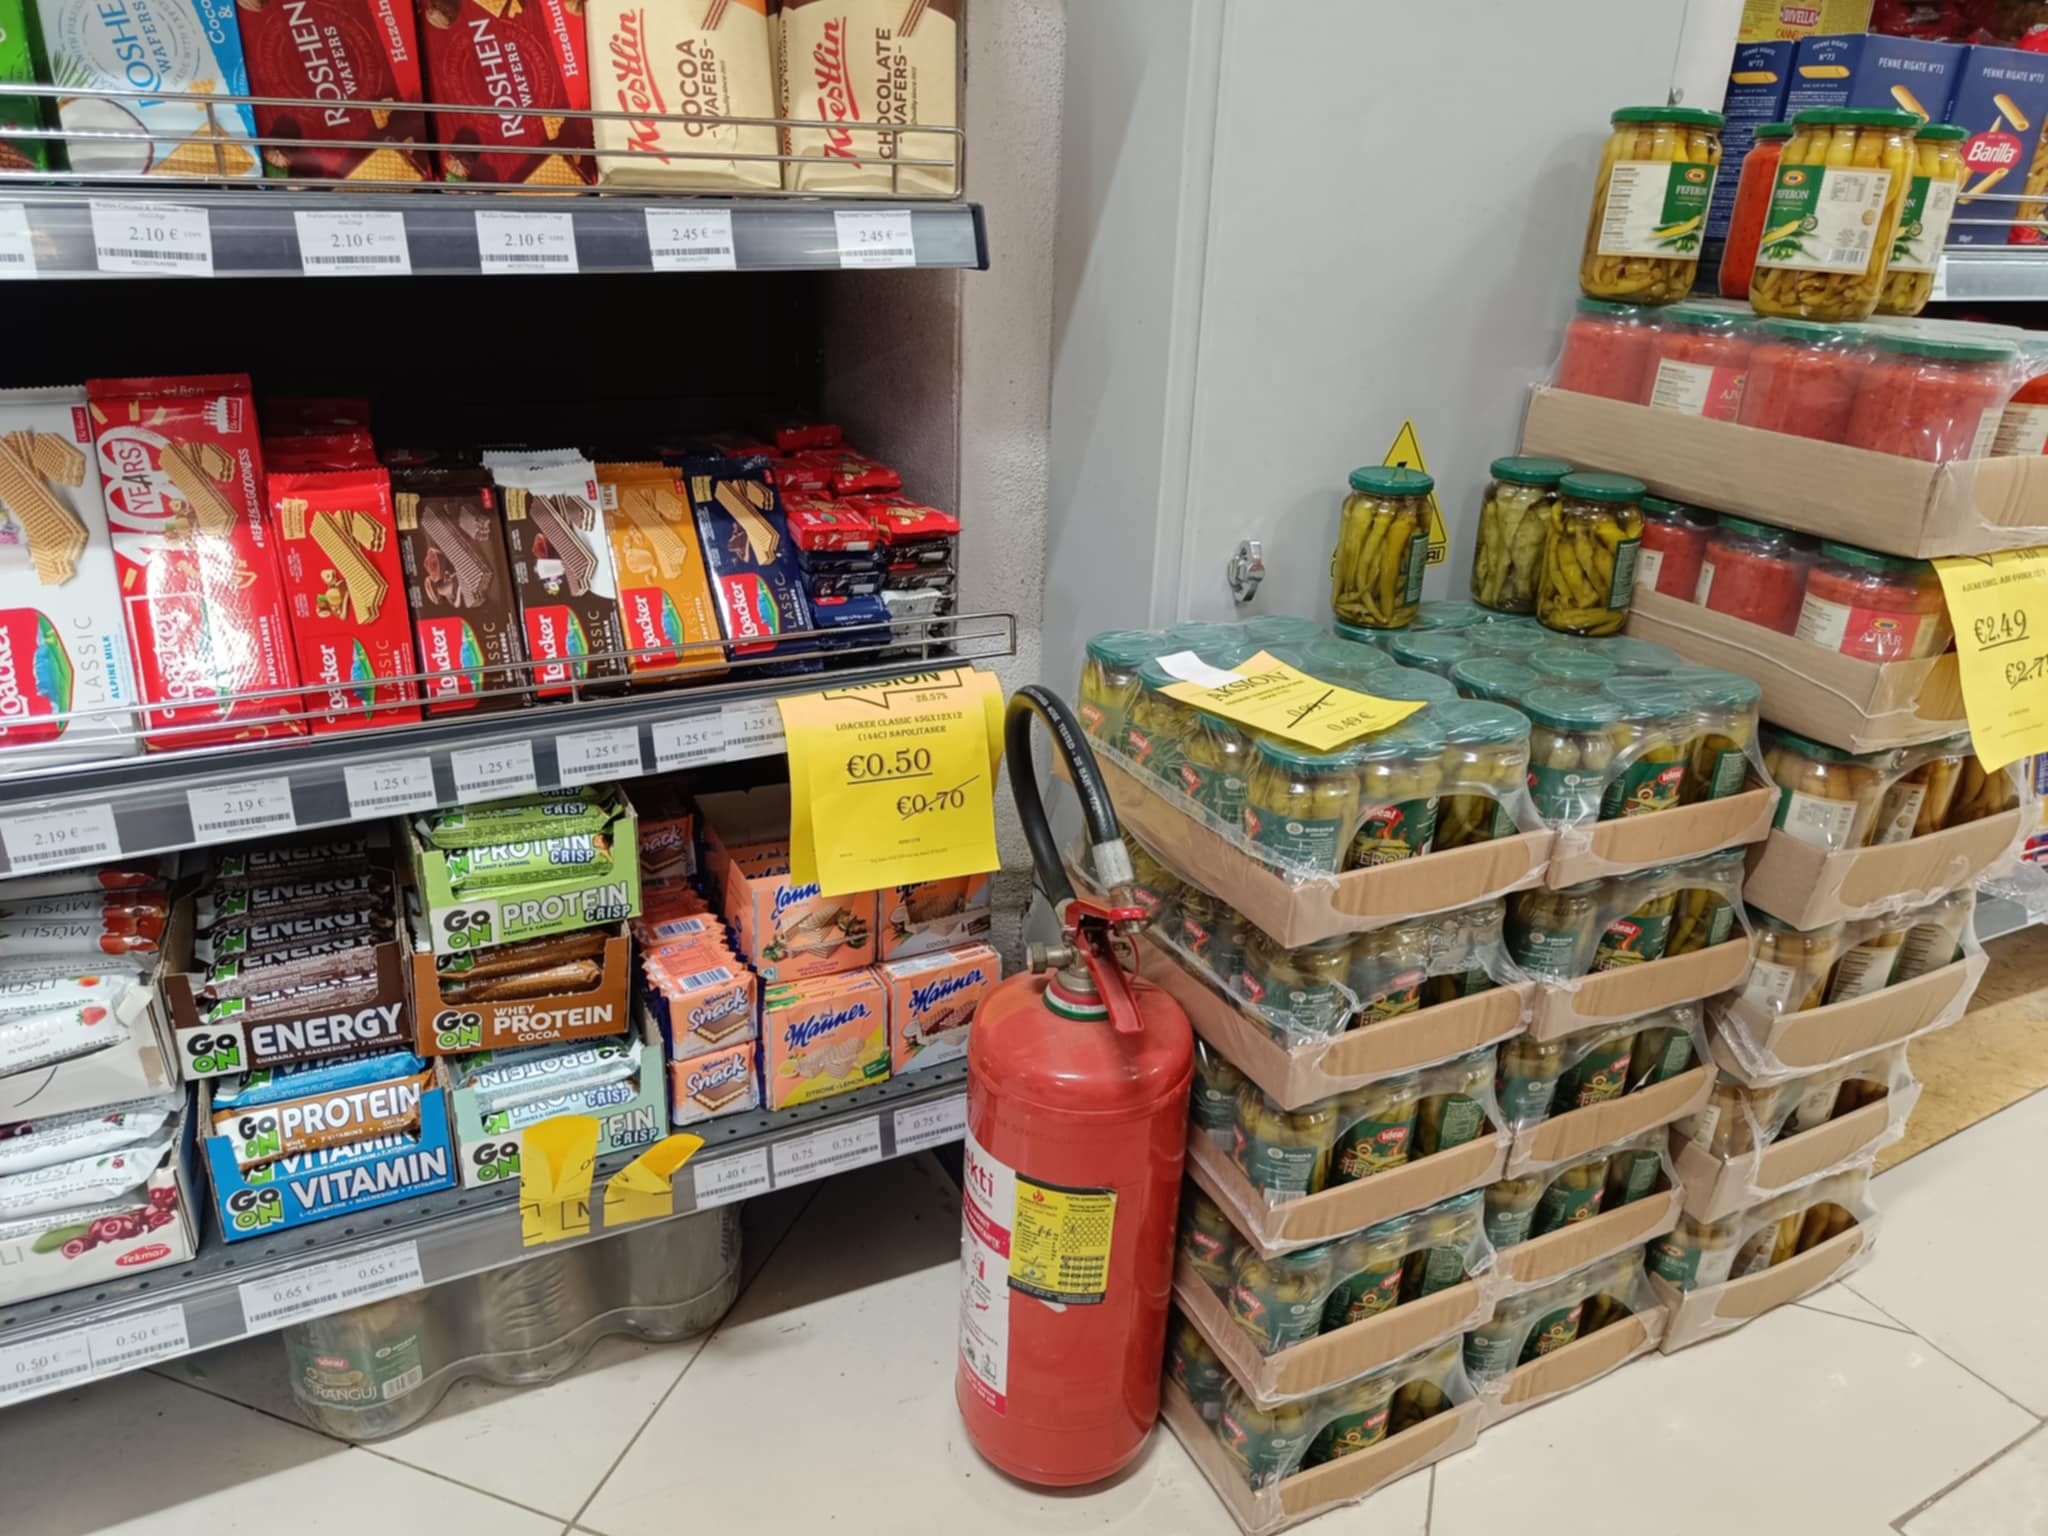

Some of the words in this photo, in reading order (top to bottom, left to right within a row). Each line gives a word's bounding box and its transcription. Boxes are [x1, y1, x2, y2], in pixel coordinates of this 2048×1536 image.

[283, 2, 350, 127] ROSHEN
[324, 26, 358, 95] WAFERS
[1878, 57, 1902, 70] PENNE
[1904, 59, 1927, 73] RIGATE
[468, 18, 525, 138] ROSHEN
[504, 42, 534, 107] WAFERS
[1982, 67, 2006, 79] PENNE
[2006, 69, 2028, 82] RIGATE
[676, 38, 705, 138] COCOA
[876, 28, 893, 160] CHOCOLATE
[1967, 141, 2017, 164] Barilla
[129, 226, 164, 242] 2.10
[168, 227, 179, 240] €
[331, 233, 363, 248] 2.10
[366, 233, 375, 246] €
[504, 232, 534, 247] 2.10
[536, 233, 545, 245] €
[671, 228, 699, 241] 2.45
[701, 228, 709, 239] €
[859, 230, 885, 243] 2.45
[886, 231, 893, 241] €
[119, 446, 154, 511] YEARS
[775, 571, 798, 630] LASSIC
[1973, 608, 2028, 645] €2.49
[101, 633, 114, 660] MILK
[259, 615, 279, 686] NAPOLITANER
[106, 661, 121, 700] ALPINE
[1207, 670, 1290, 702] AKSION
[743, 717, 766, 731] 1.25
[767, 716, 775, 727] €
[877, 716, 912, 727] CLASSIC
[675, 732, 700, 748] 1.25
[702, 730, 709, 742] €
[585, 745, 611, 760] 1.25
[612, 744, 620, 755] €
[847, 748, 932, 779] €0.50
[478, 761, 503, 776] 1.25
[505, 759, 514, 770] €
[373, 776, 400, 792] 1.25
[402, 775, 411, 787] €
[223, 797, 254, 815] 2.19
[257, 796, 266, 808] €
[542, 802, 588, 816] CRISP
[896, 788, 966, 818] €0.70
[34, 829, 66, 847] 2.19
[69, 827, 79, 839] €
[639, 826, 682, 851] nack
[550, 849, 595, 864] CRISP
[252, 874, 372, 902] ENERGY
[502, 880, 628, 930] PROTEIN
[583, 903, 632, 923] CRISP
[251, 909, 372, 941] ENERGY
[443, 910, 491, 932] GO
[447, 922, 493, 949] ON
[908, 968, 989, 1018] Manner
[435, 1010, 482, 1032] GO
[493, 1004, 535, 1017] WHEY
[493, 1004, 614, 1036] PROTEIN
[687, 987, 748, 1032] Snack
[250, 1002, 403, 1057] ENERGY
[438, 1025, 482, 1048] ON
[517, 1029, 561, 1042] COCOA
[785, 1003, 872, 1051] Manner
[187, 1032, 238, 1057] GO
[193, 1046, 241, 1073] ON
[480, 1050, 597, 1088] PROTEIN
[686, 1053, 747, 1099] Snack
[585, 1086, 632, 1108] CRISP
[282, 1082, 421, 1139] PROTEIN
[599, 1104, 655, 1140] TEIN
[913, 1116, 935, 1129] 0.75
[238, 1115, 278, 1140] GO
[611, 1127, 659, 1148] CRISP
[244, 1130, 281, 1158] ON
[472, 1141, 519, 1166] GO
[791, 1148, 814, 1162] 0.75
[831, 1136, 854, 1151] 0.75
[291, 1146, 447, 1210] VITAMIN
[477, 1154, 521, 1181] ON
[716, 1169, 740, 1184] 1.40
[740, 1165, 748, 1175] €
[228, 1188, 281, 1213] GO
[235, 1202, 283, 1230] ON
[122, 1247, 167, 1265] Tekmar
[357, 1262, 386, 1280] 0.65
[388, 1260, 397, 1272] €
[273, 1284, 302, 1303] 0.65
[305, 1282, 314, 1293] €
[115, 1328, 148, 1347] 0.50
[150, 1326, 161, 1337] €
[16, 1355, 49, 1374] 0.50
[51, 1352, 61, 1364] €
